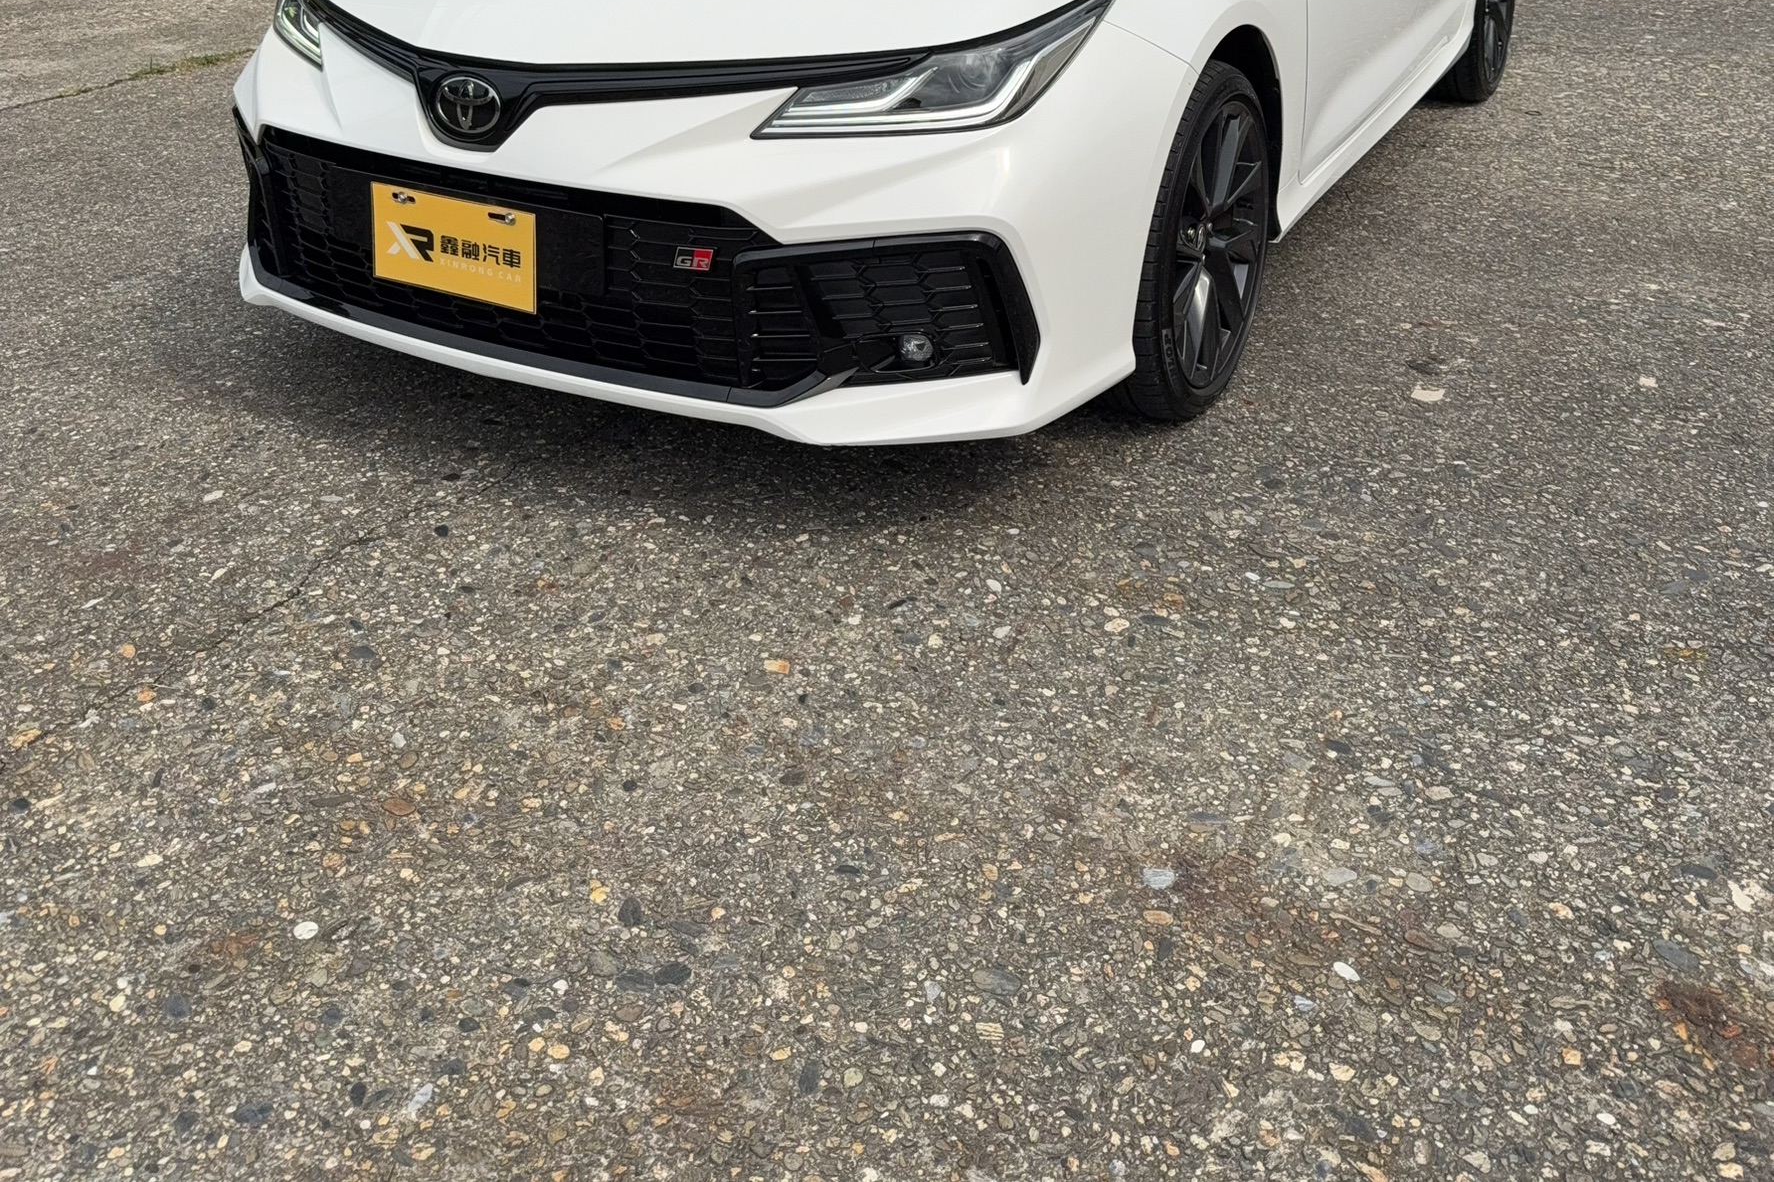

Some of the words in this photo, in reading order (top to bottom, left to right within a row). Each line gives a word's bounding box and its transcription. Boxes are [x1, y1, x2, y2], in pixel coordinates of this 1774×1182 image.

[440, 235, 521, 269] 鑫融汽車
[676, 255, 709, 268] GR
[439, 258, 494, 277] XINRONG
[498, 271, 522, 283] CAR
